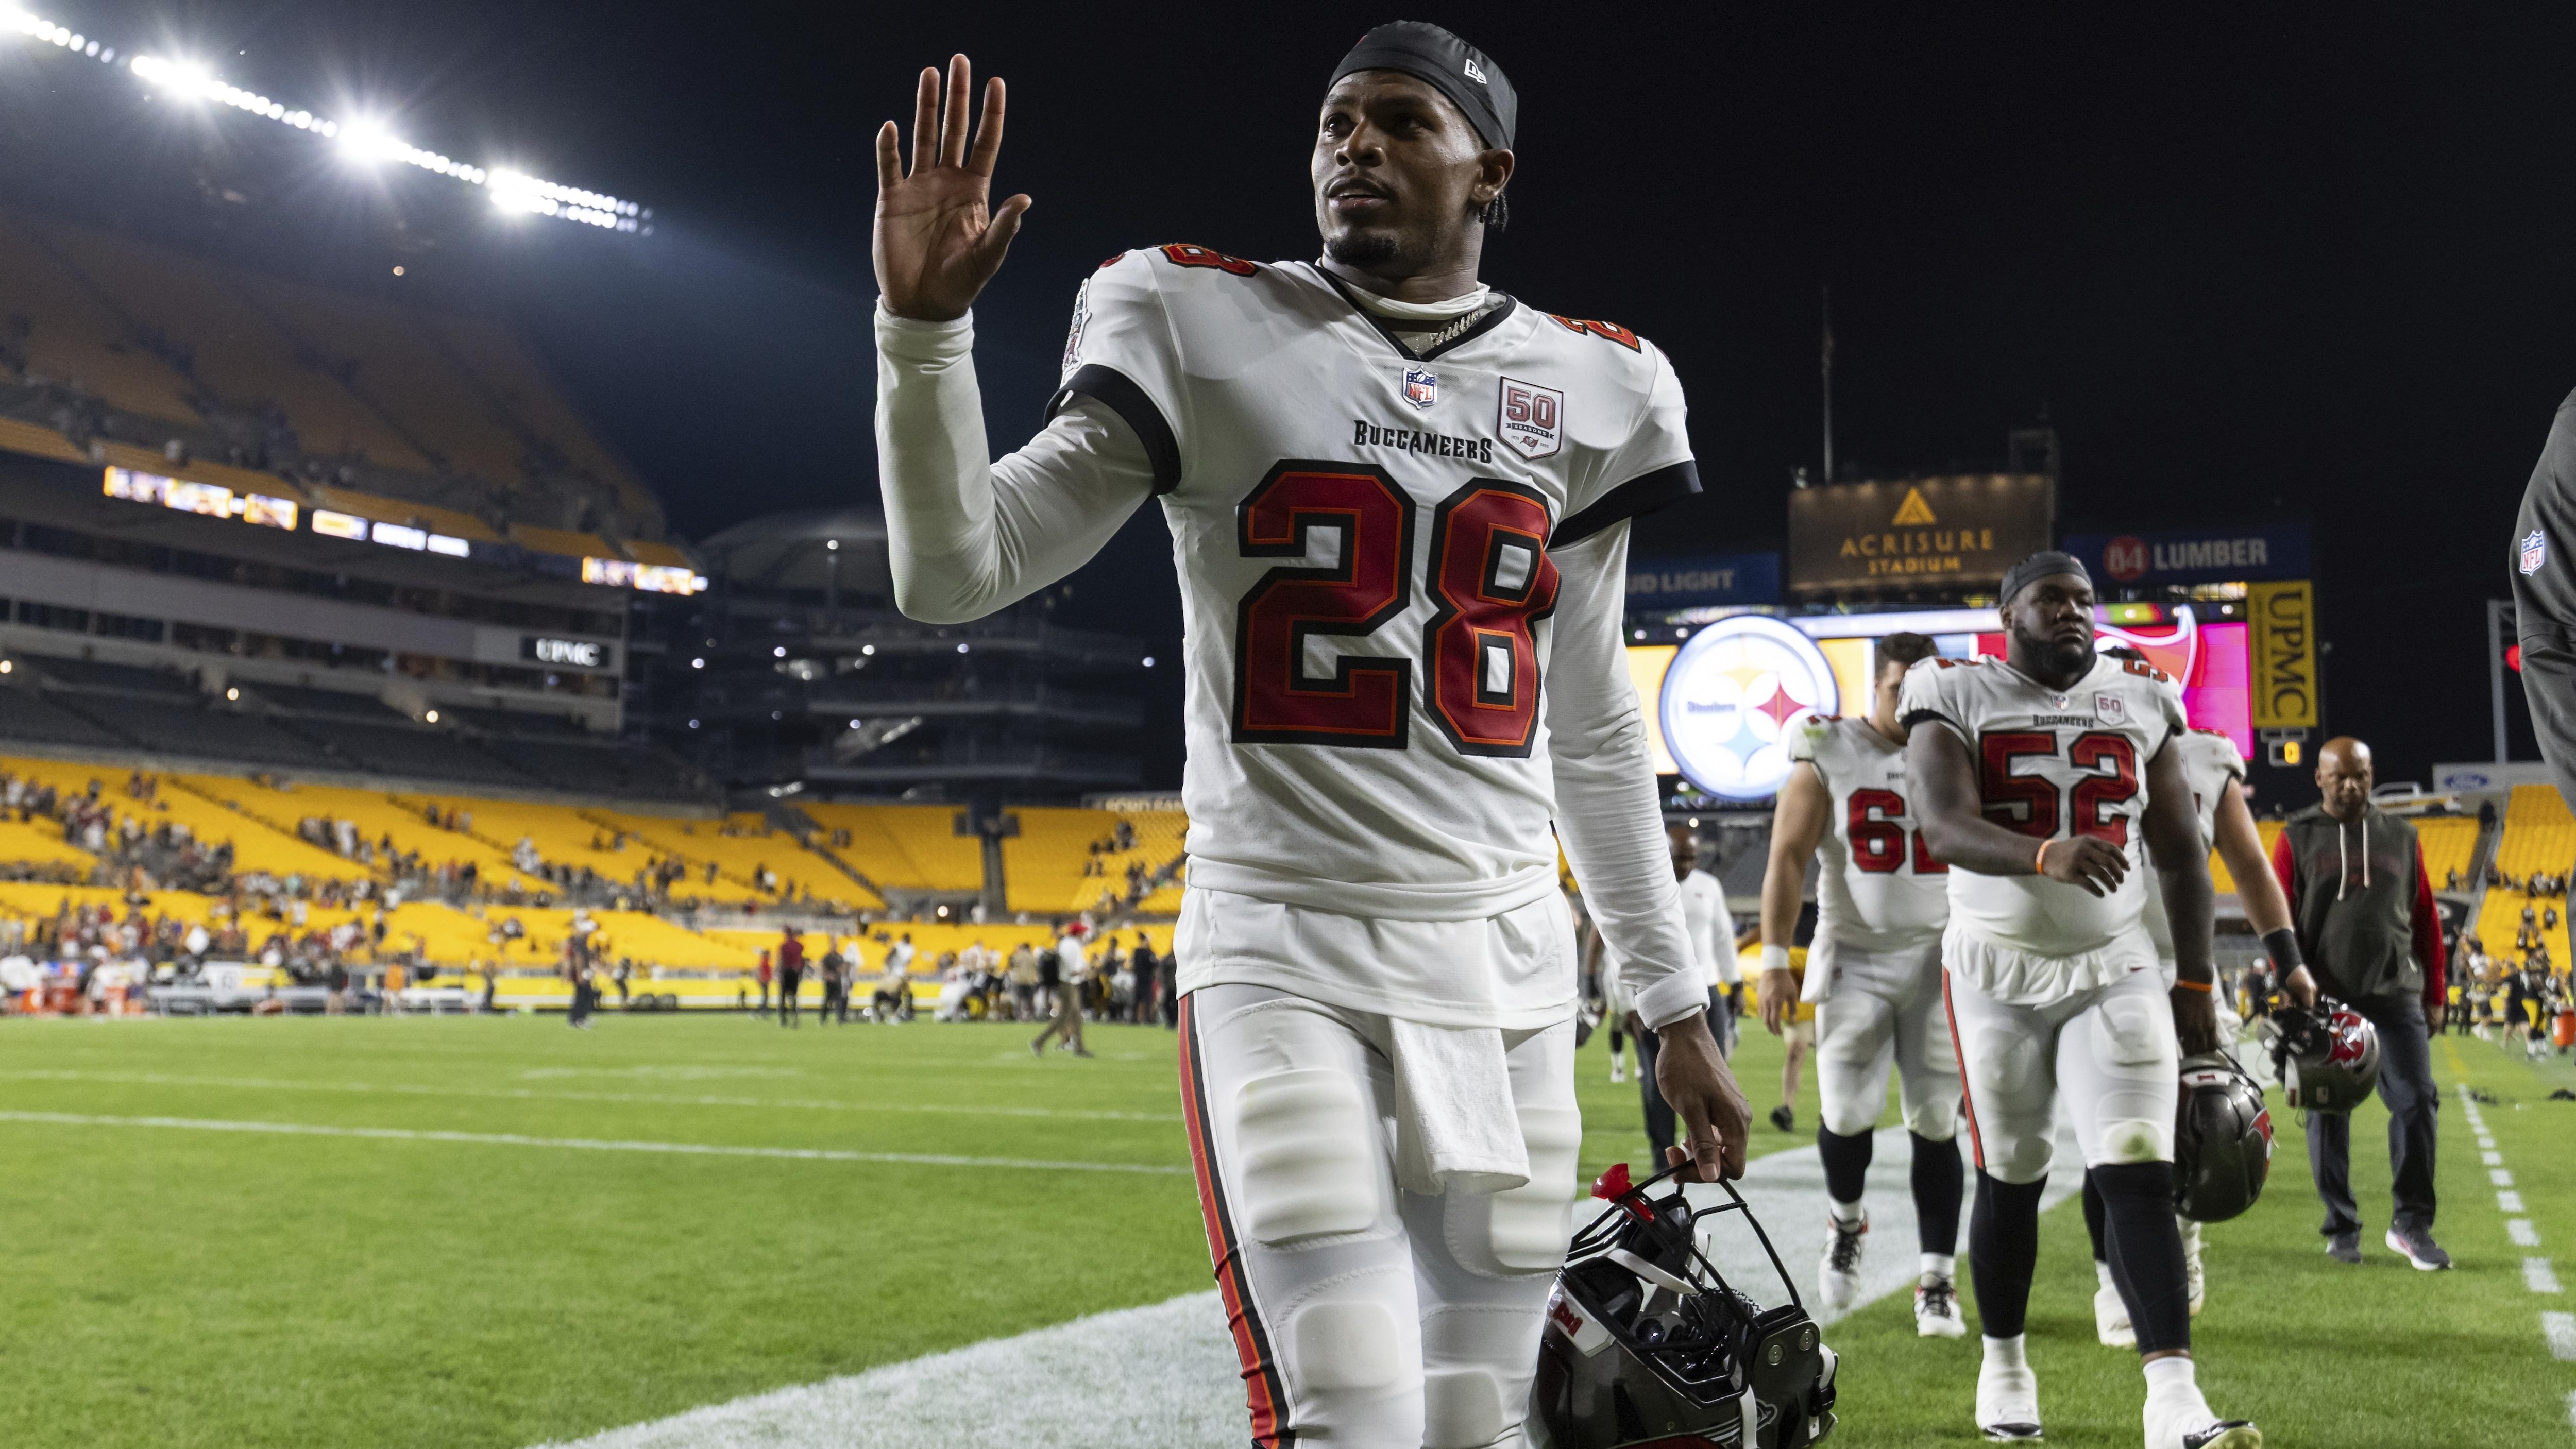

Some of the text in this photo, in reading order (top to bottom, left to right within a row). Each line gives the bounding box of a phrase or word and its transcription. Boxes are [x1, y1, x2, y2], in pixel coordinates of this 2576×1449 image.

[1408, 383, 1432, 401] NFL
[1506, 386, 1556, 430] 50
[1354, 420, 1492, 464] BUCCANEERS
[1514, 424, 1548, 437] SEASONS
[1840, 529, 1993, 557] ACRISURE
[2109, 539, 2267, 573] 84 LUMBER
[1869, 556, 1961, 576] STADIUM
[2523, 549, 2541, 569] NFL
[1625, 568, 1735, 594] UD LIGHT
[1232, 459, 1562, 759] 28
[536, 638, 600, 667] UPMC
[2269, 591, 2308, 718] UPMC
[1979, 730, 2139, 849] 52
